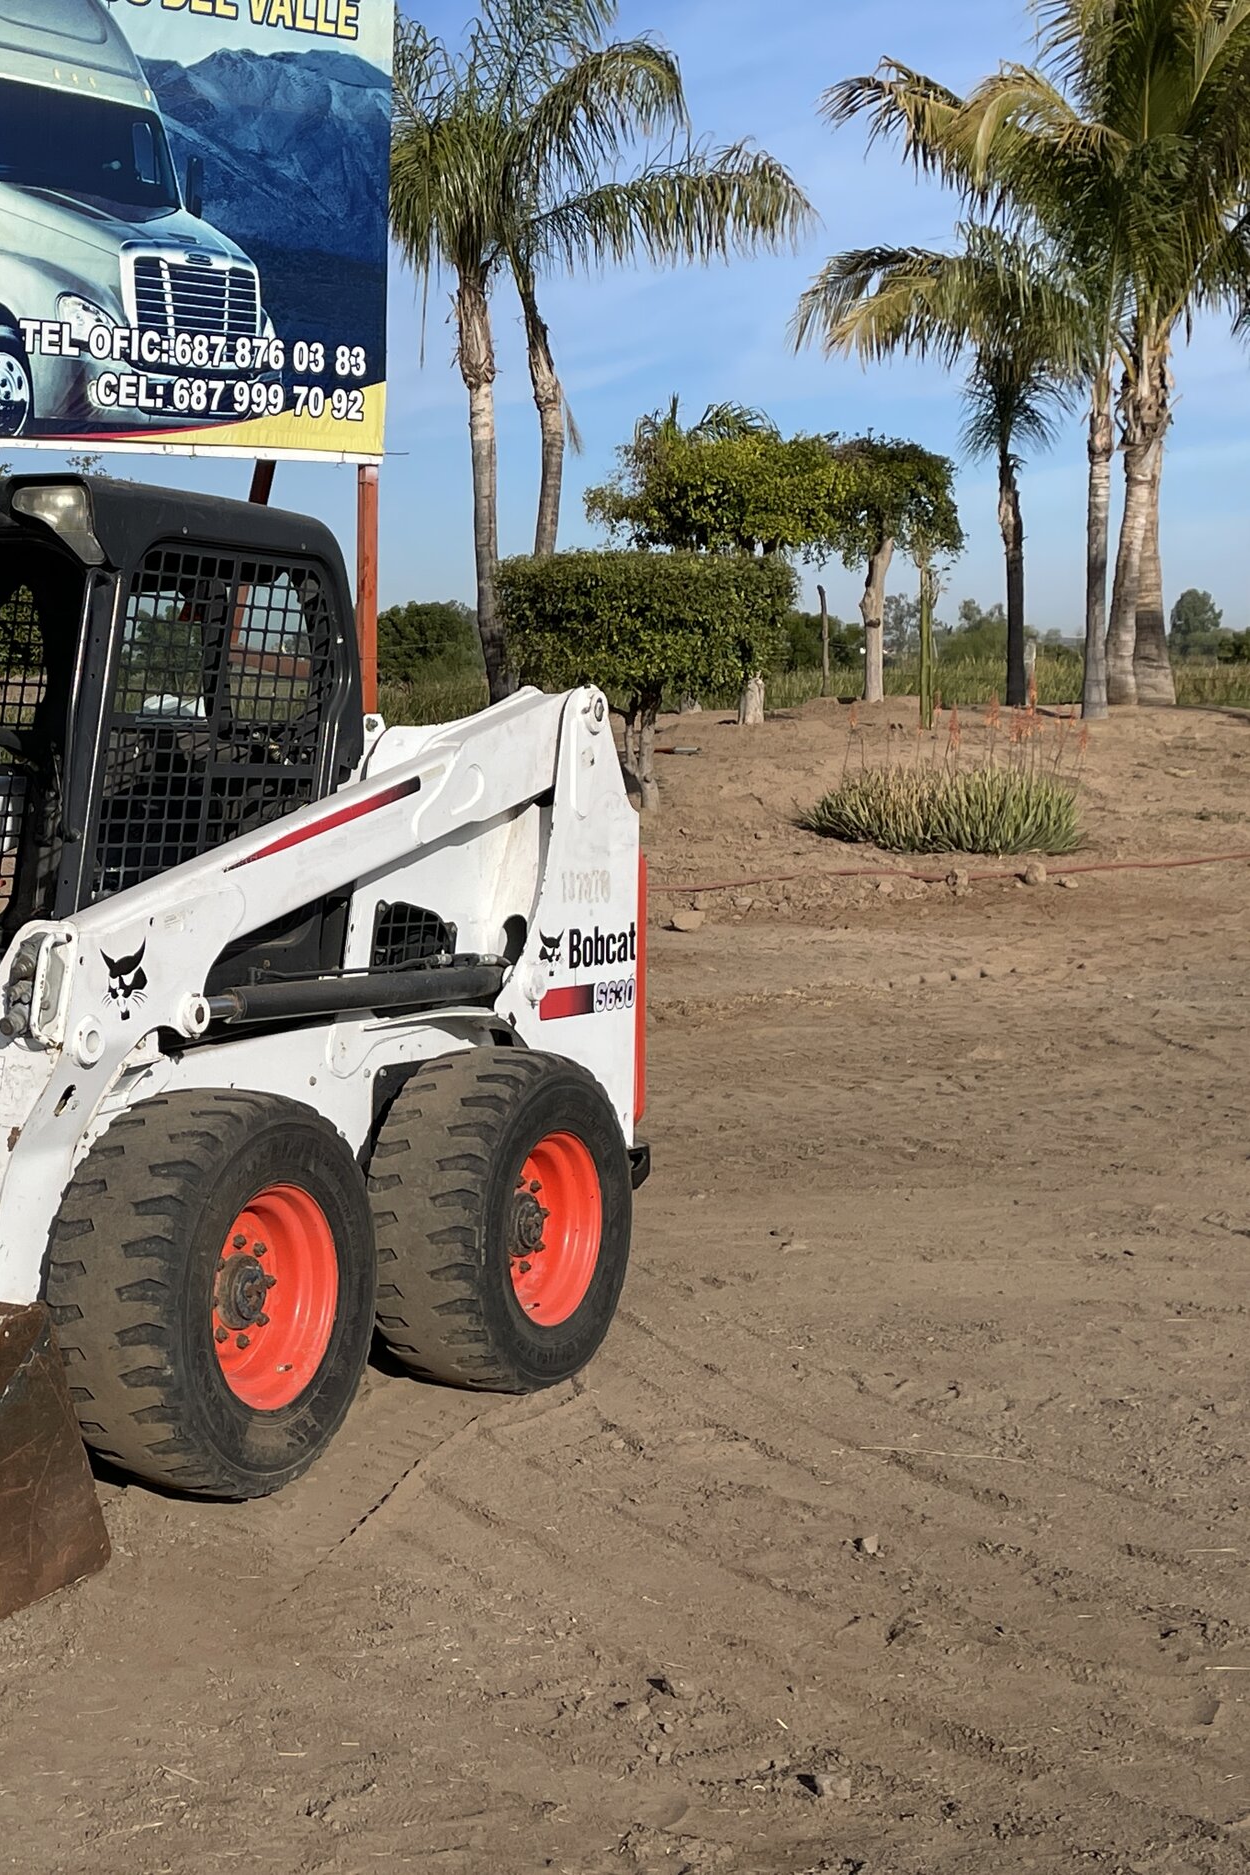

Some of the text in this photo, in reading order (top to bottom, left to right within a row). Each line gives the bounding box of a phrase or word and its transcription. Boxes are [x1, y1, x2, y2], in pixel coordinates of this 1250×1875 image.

[248, 0, 359, 40] VALLE
[19, 319, 81, 357] TEL
[234, 338, 286, 371] 876
[293, 340, 326, 374] 03
[334, 345, 367, 377] 83
[96, 372, 365, 421] CEL: 687 999 70 92
[568, 922, 636, 970] Bobcat
[595, 978, 636, 1013] S630
